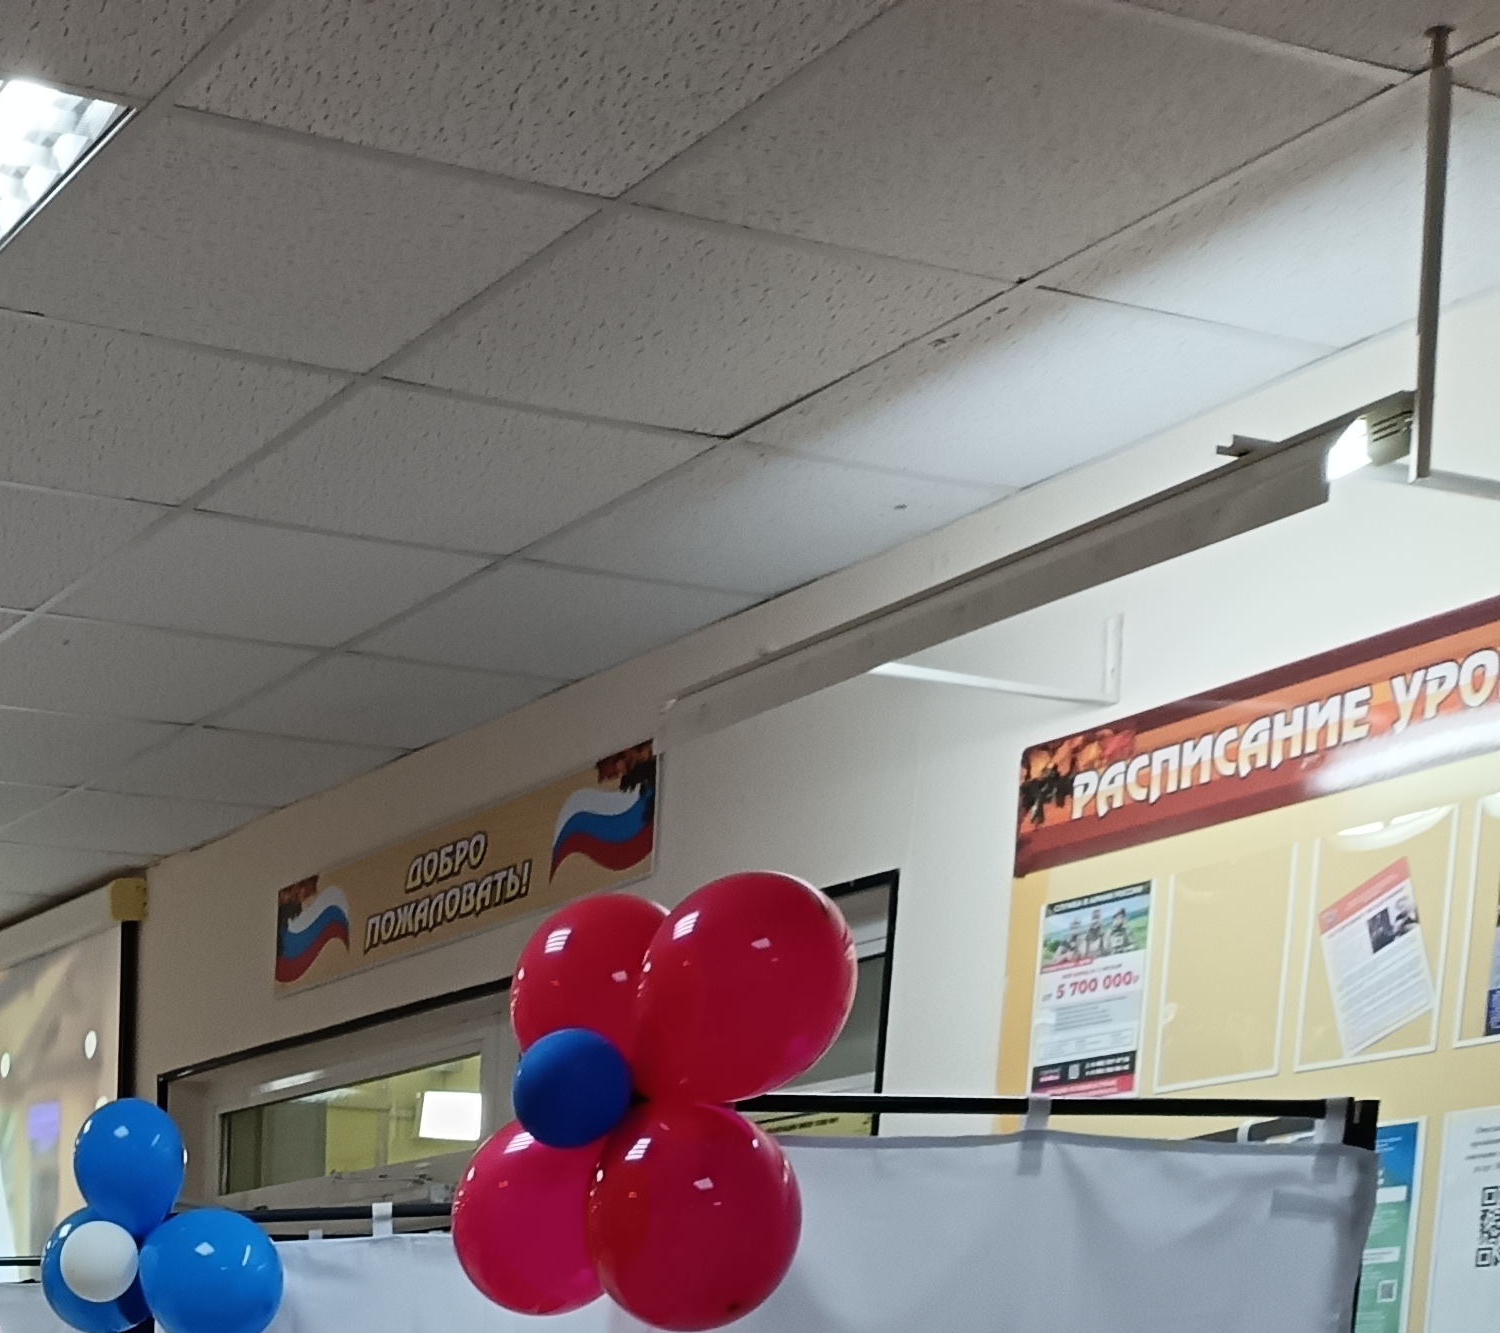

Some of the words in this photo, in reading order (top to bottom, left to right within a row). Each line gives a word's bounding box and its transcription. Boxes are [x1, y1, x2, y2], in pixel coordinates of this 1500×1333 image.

[1070, 683, 1374, 821] РАСПИСАНИЕ
[1389, 646, 1500, 736] УРО
[404, 831, 488, 892] ДОБРО
[363, 859, 533, 954] ПОЖАЛОВАТЬ!
[1056, 983, 1067, 999] 5
[1069, 977, 1098, 997] 700
